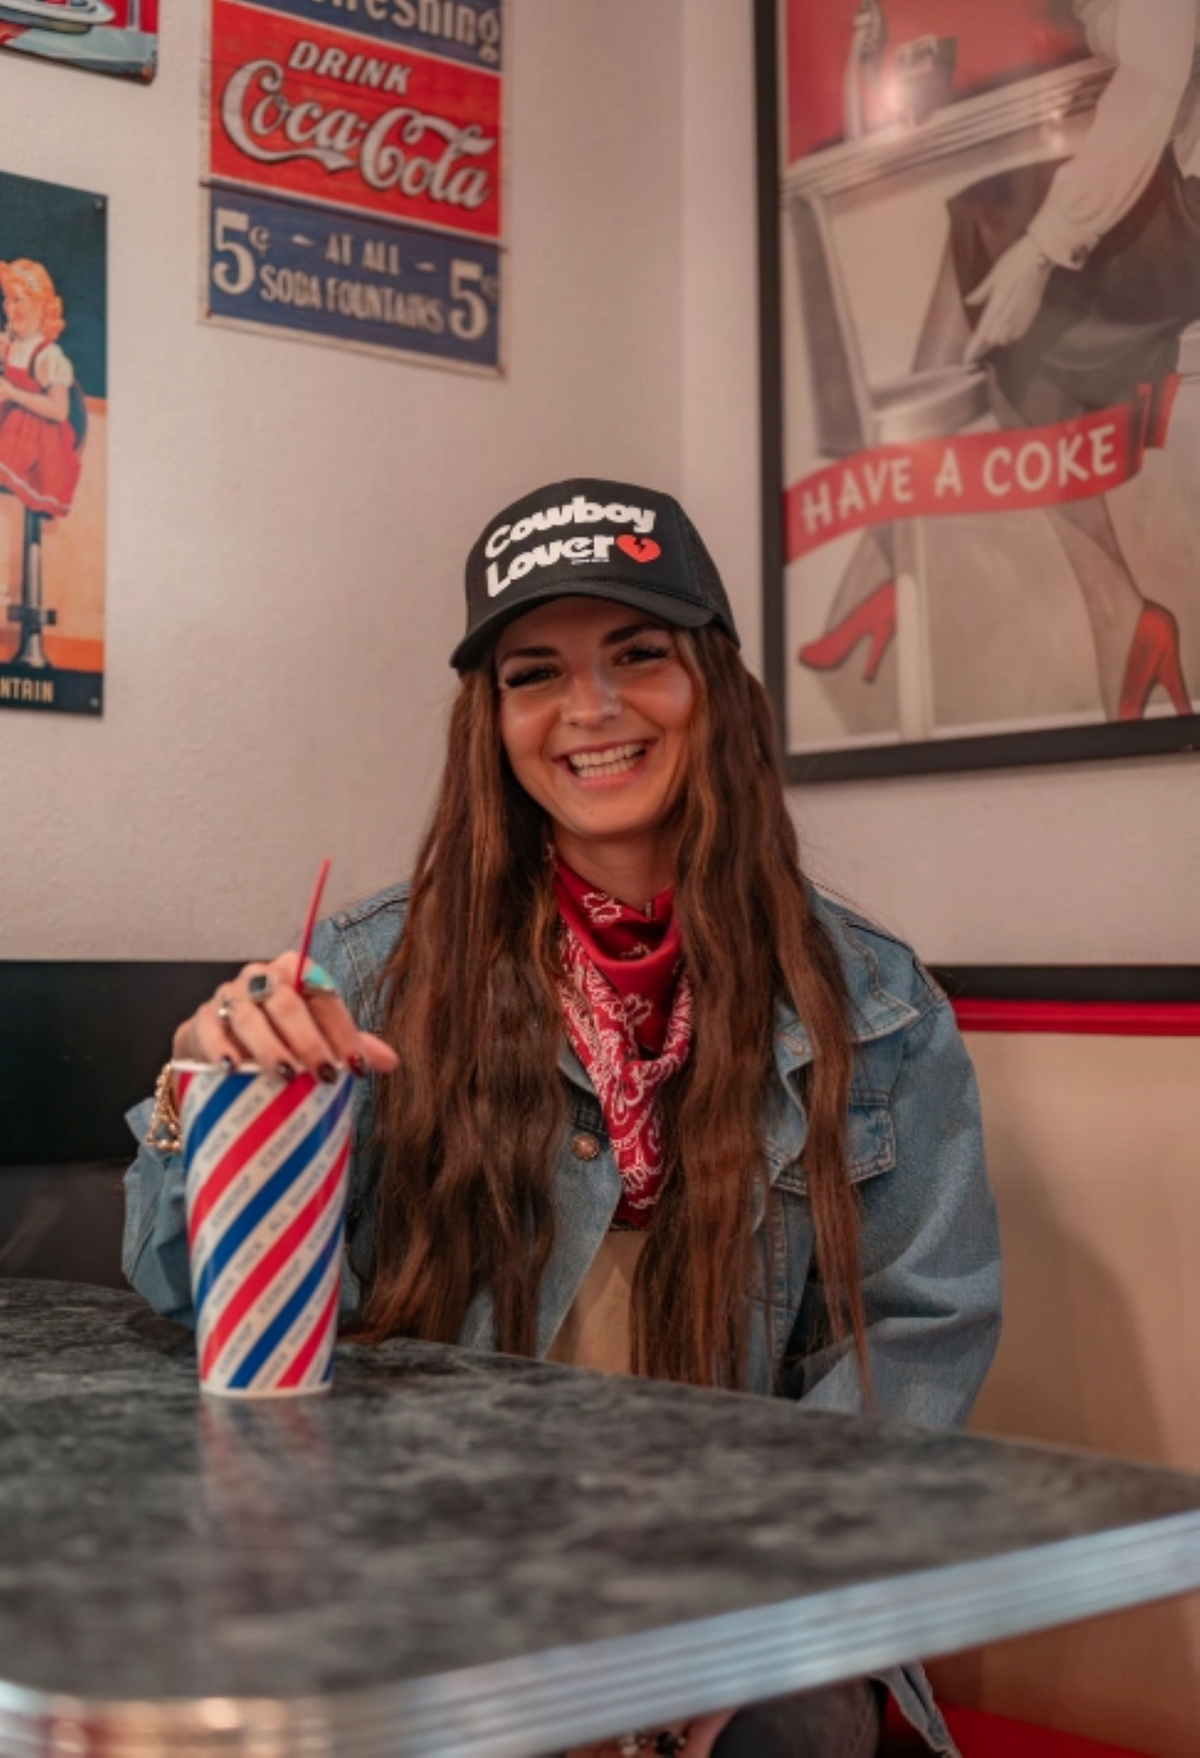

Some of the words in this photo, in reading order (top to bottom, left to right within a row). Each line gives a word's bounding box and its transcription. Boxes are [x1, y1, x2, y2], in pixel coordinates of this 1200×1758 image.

[288, 40, 412, 95] DRINK
[325, 232, 353, 265] AT
[361, 240, 400, 276] ALL
[260, 264, 321, 309] SODA
[326, 277, 444, 334] FOUNTAINS
[801, 456, 914, 536] HAVE
[934, 448, 963, 498] A
[982, 424, 1116, 497] COKE
[484, 495, 656, 559] Cowboy
[485, 534, 615, 598] Lover
